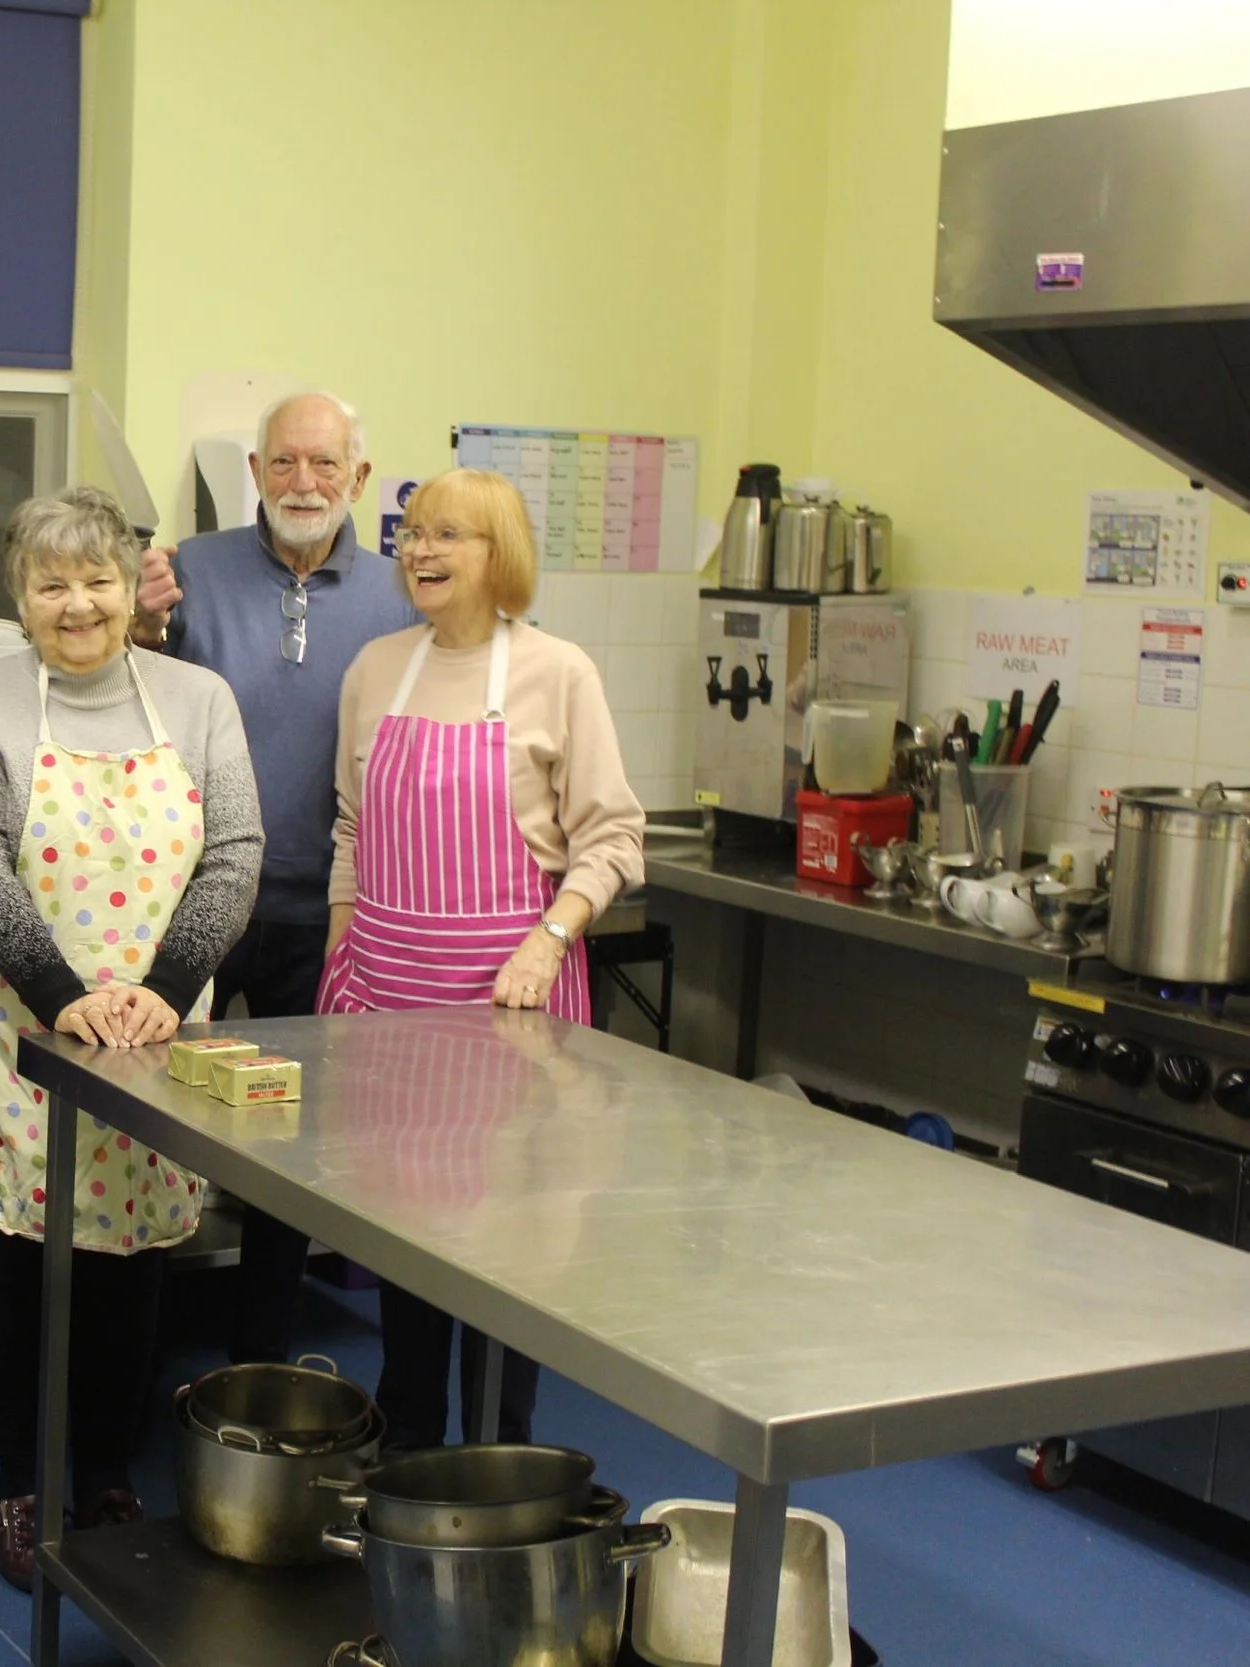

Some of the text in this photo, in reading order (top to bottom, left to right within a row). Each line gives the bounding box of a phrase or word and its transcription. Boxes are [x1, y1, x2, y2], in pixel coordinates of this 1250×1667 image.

[976, 631, 1071, 656] RAW MEAT
[1002, 658, 1038, 673] AREA
